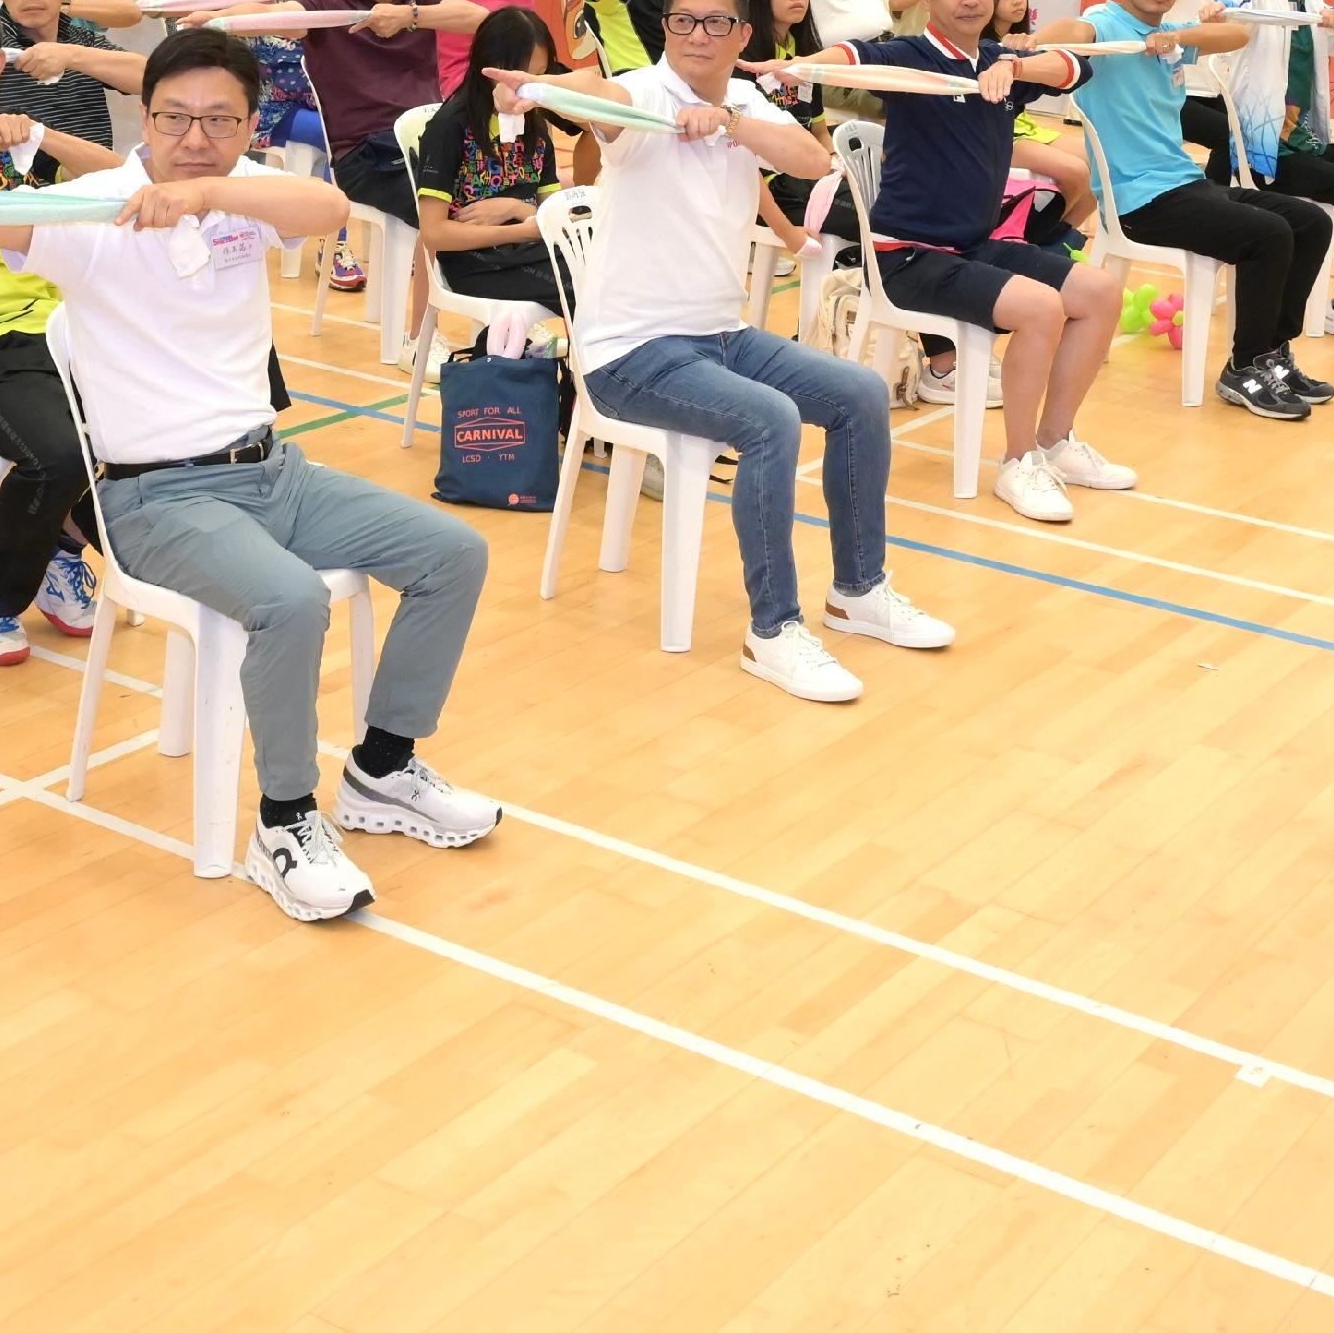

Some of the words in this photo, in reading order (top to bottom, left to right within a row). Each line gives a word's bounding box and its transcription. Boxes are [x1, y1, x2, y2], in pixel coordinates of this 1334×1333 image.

[458, 408, 479, 418] SPORT
[483, 406, 501, 415] FOR
[506, 405, 521, 415] ALL
[456, 427, 523, 443] CARNIVAL
[462, 453, 482, 464] LCSD
[498, 452, 515, 462] YTM
